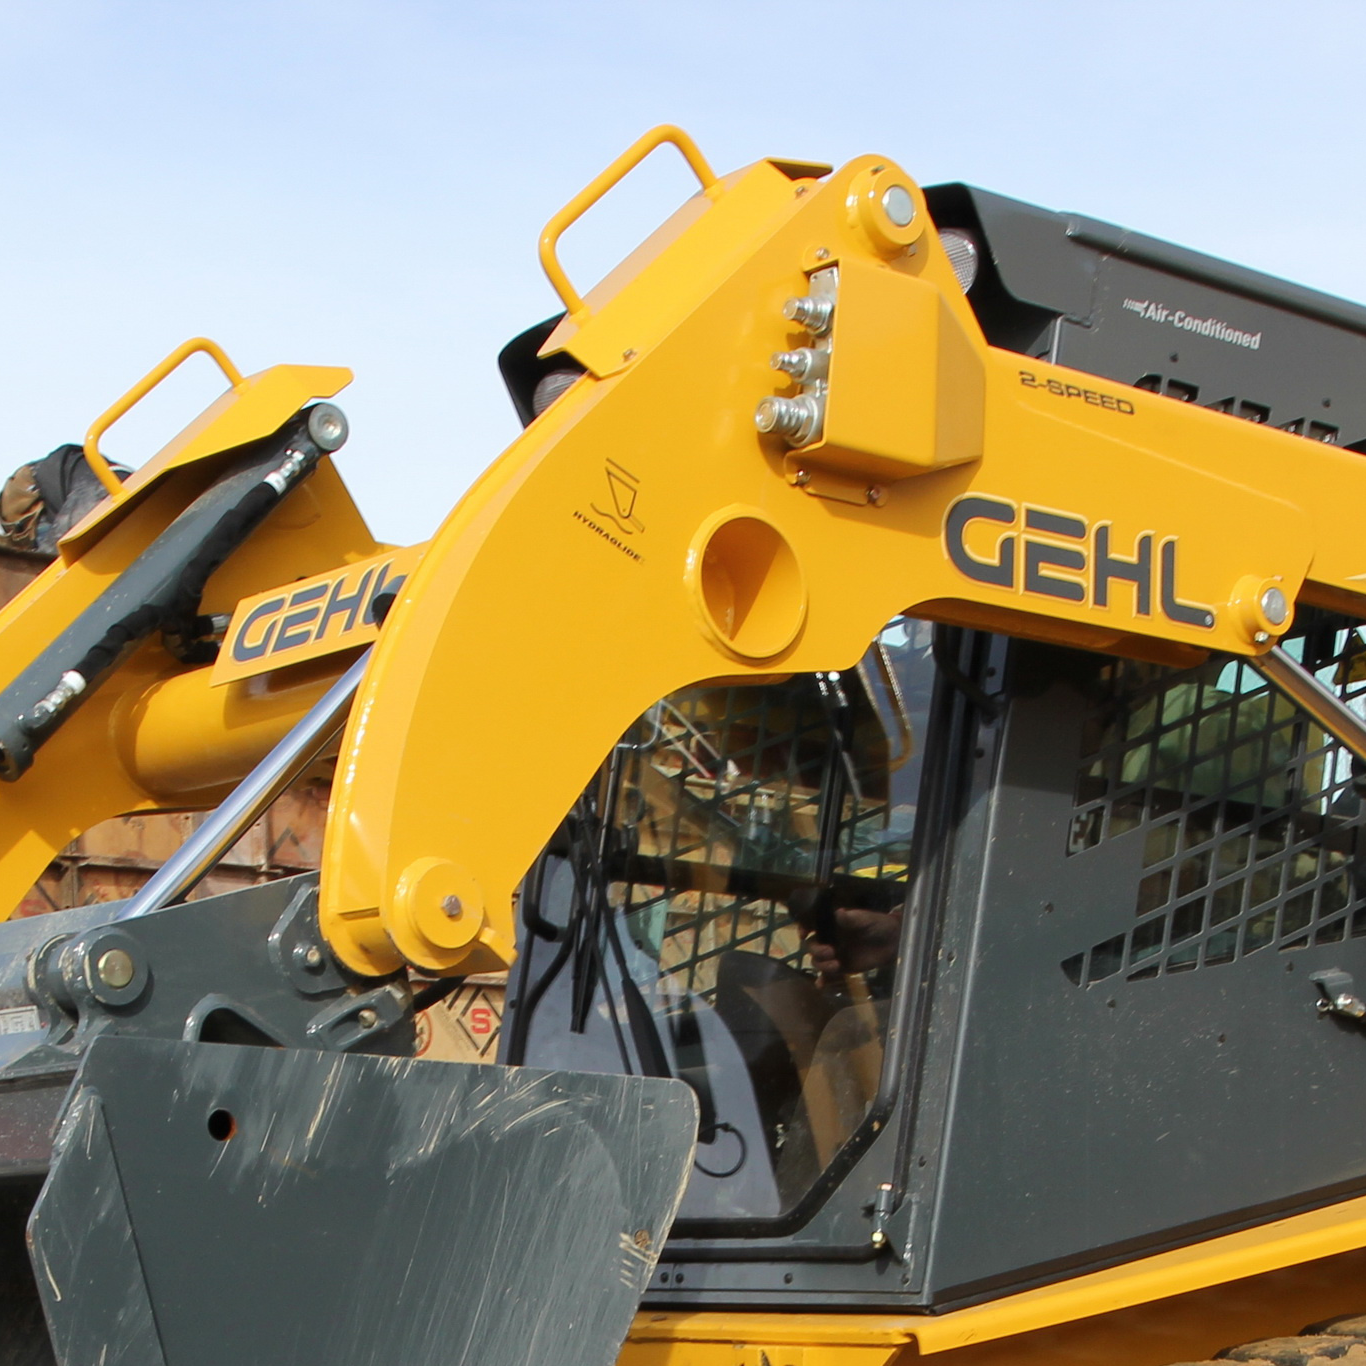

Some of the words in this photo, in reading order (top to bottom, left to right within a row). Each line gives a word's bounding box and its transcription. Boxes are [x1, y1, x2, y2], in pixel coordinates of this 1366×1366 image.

[1144, 302, 1262, 350] Air-Conditioned
[1019, 370, 1135, 415] 2-SPEED
[943, 495, 1216, 630] GEHL
[230, 560, 394, 663] GEHL
[471, 1008, 492, 1034] S
